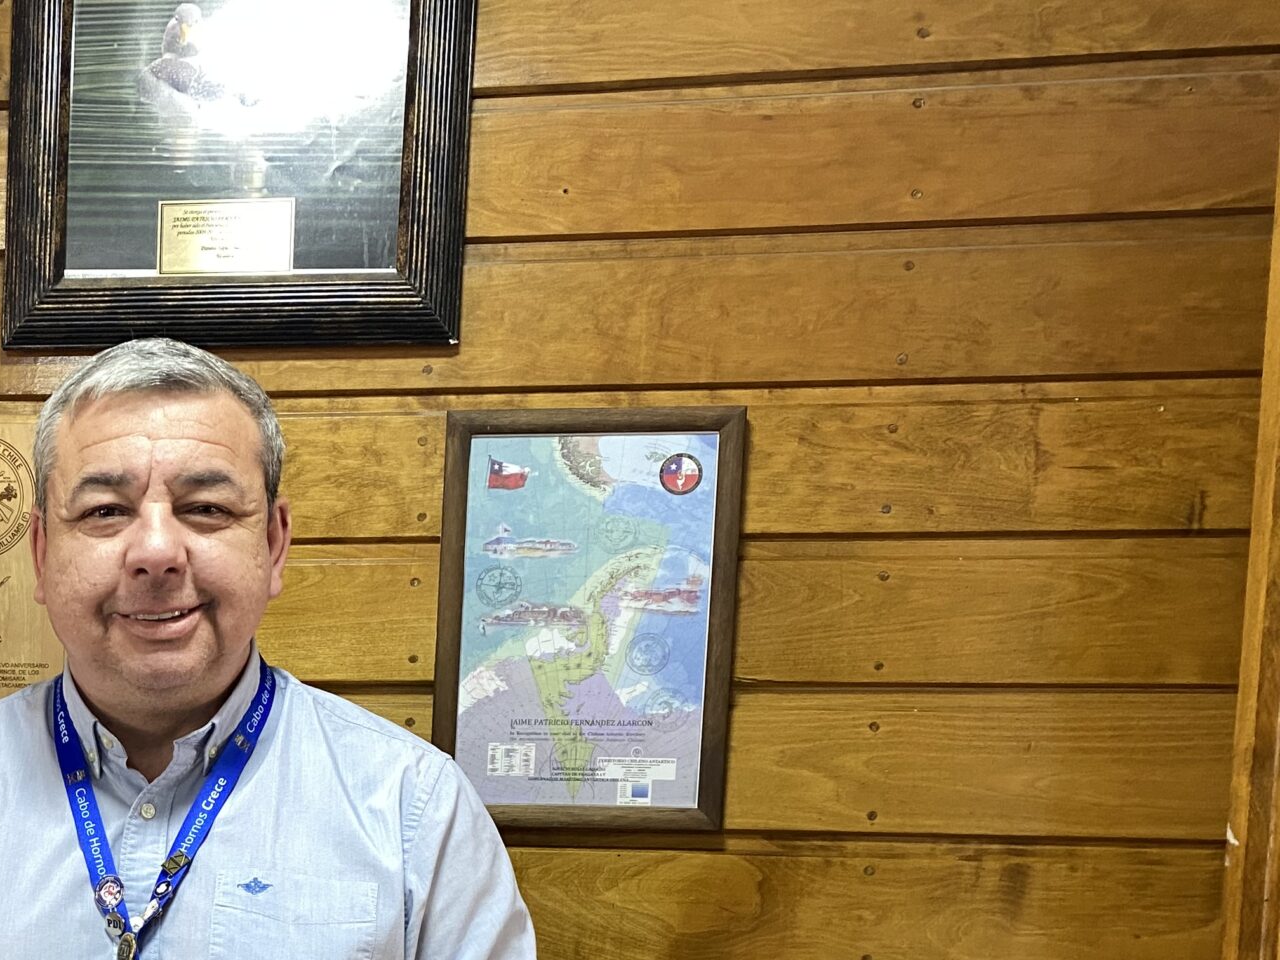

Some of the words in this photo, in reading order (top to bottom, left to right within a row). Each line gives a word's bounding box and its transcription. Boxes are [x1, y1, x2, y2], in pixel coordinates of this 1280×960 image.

[1, 448, 24, 470] CHILE
[57, 711, 69, 744] Crece
[246, 704, 265, 733] Cabo
[261, 690, 270, 705] de
[510, 718, 532, 730] JAIME
[533, 718, 569, 726] PATRICIO
[75, 787, 90, 818] Cabo
[179, 811, 208, 853] Hornos
[201, 777, 227, 811] Crece
[84, 820, 96, 837] de
[89, 837, 107, 880] Horno
